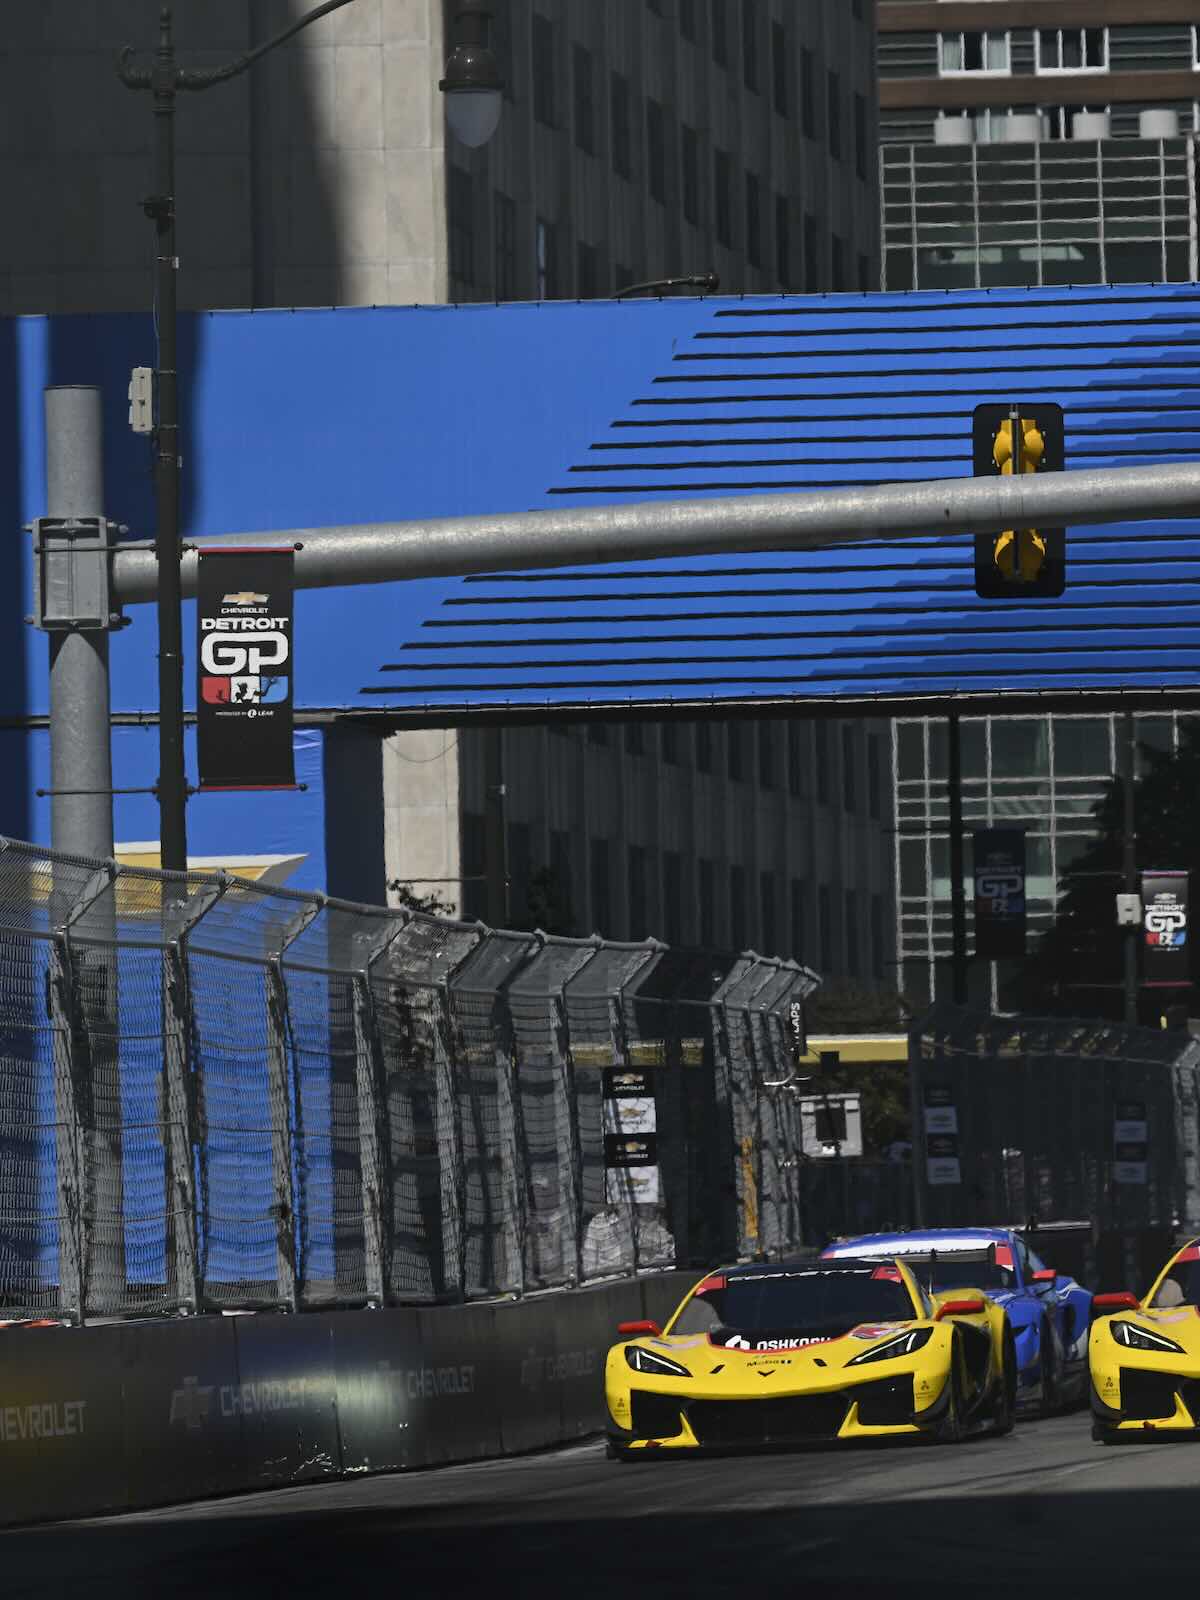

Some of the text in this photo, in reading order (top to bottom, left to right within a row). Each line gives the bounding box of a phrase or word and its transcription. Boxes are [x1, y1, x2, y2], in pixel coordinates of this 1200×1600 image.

[220, 607, 269, 615] CHEVROLET
[201, 617, 289, 630] DETROIT
[201, 631, 289, 675] GP
[977, 875, 1023, 897] GP
[1145, 911, 1187, 933] GP
[406, 1364, 476, 1399] CHEVROLET
[219, 1378, 306, 1417] CHEVROLET
